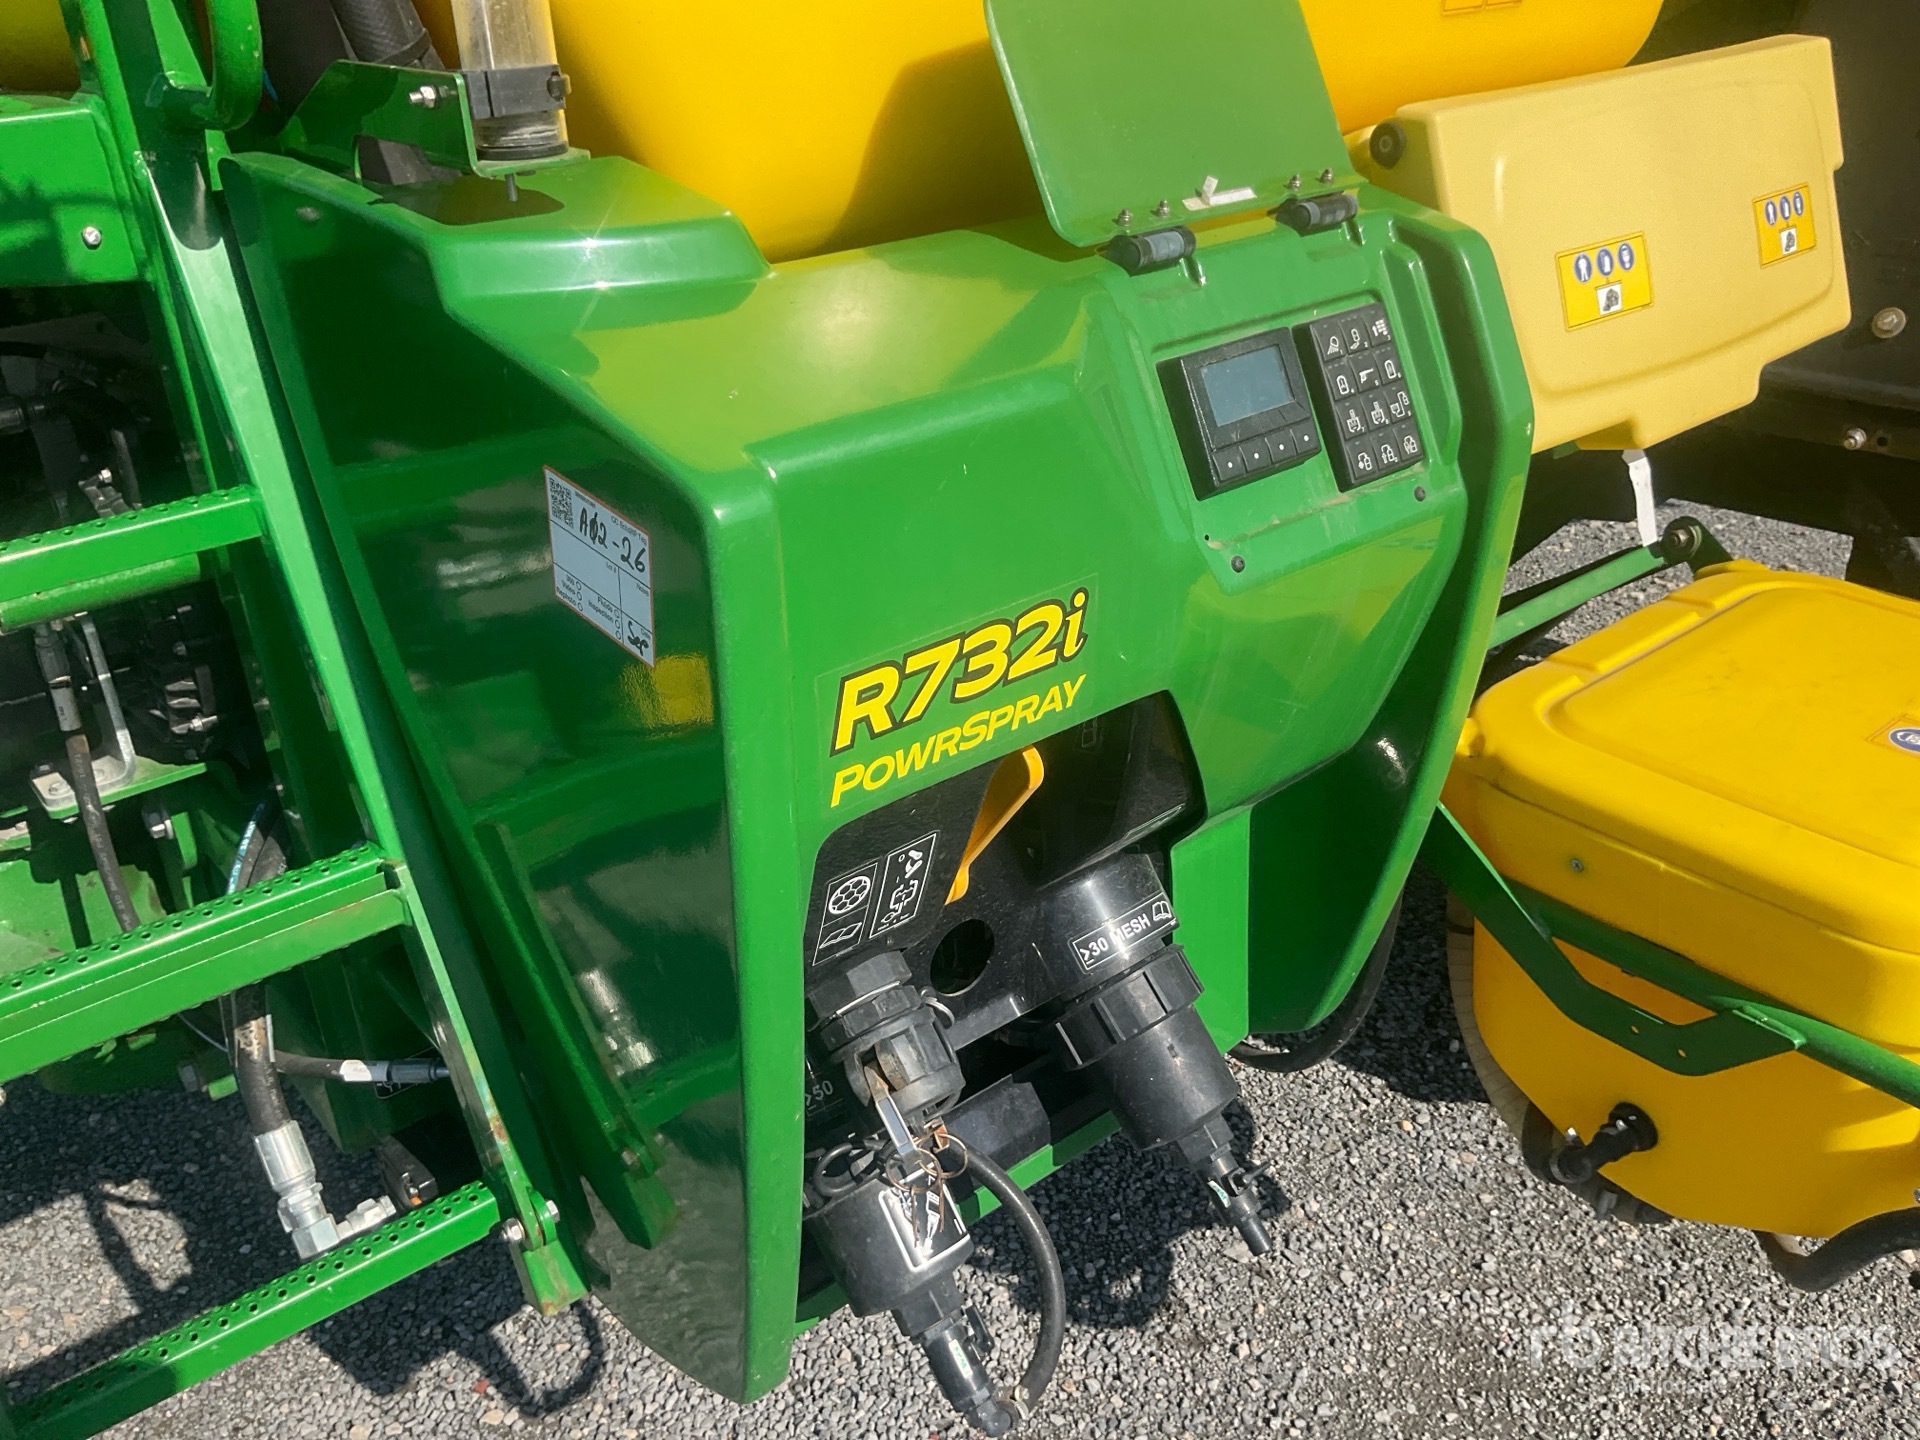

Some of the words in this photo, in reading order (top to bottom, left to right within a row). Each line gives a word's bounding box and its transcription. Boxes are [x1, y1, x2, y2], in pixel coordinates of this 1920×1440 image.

[562, 580, 575, 594] Video
[588, 600, 614, 623] Inspection
[598, 596, 613, 613] Fluids
[831, 588, 1088, 756] R732i
[830, 674, 1087, 808] POWRSPRAY
[1108, 913, 1151, 946] MESH
